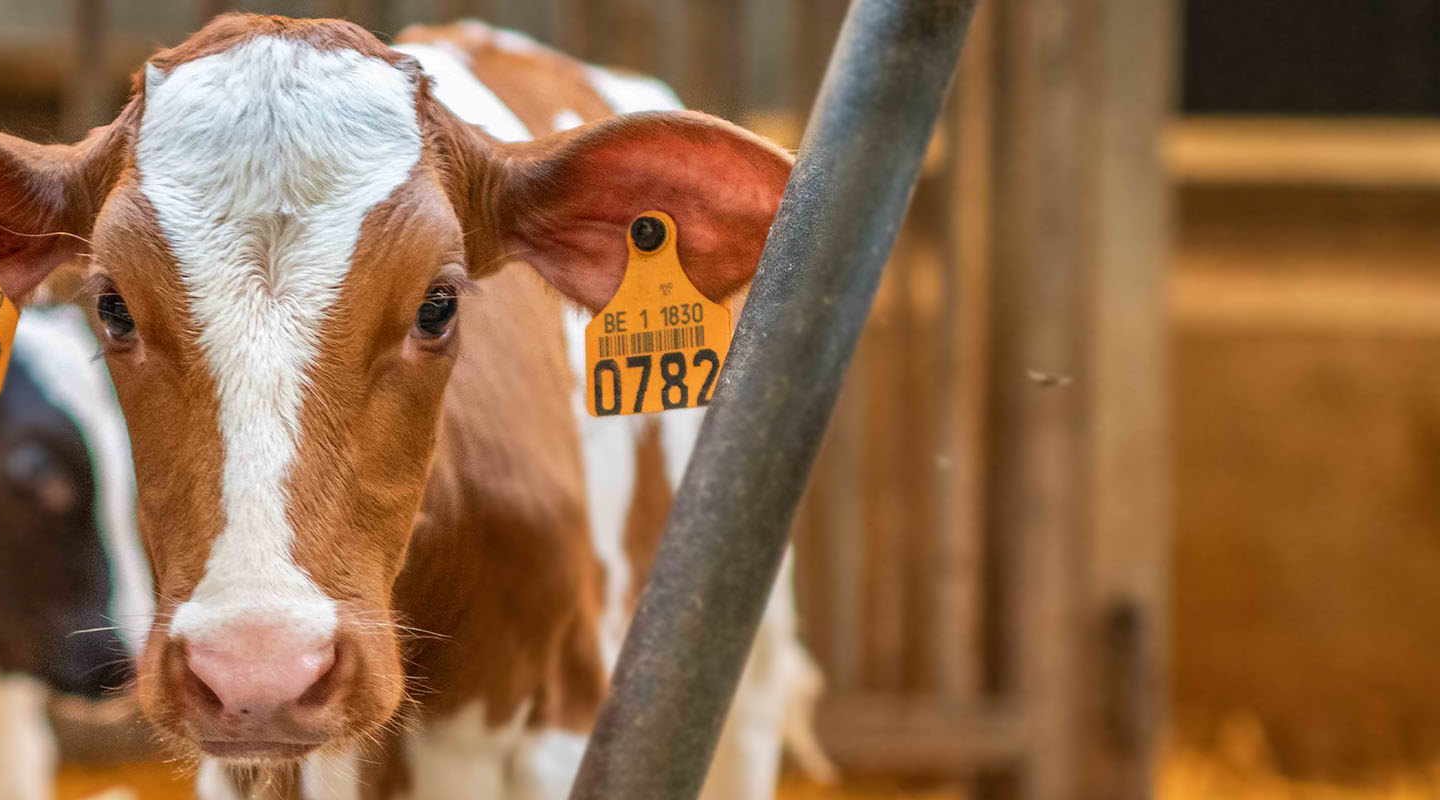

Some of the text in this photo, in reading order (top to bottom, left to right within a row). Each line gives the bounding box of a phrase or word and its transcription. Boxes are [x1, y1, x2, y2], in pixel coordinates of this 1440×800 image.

[604, 302, 704, 334] BE 1 1830
[593, 348, 720, 417] 0782
